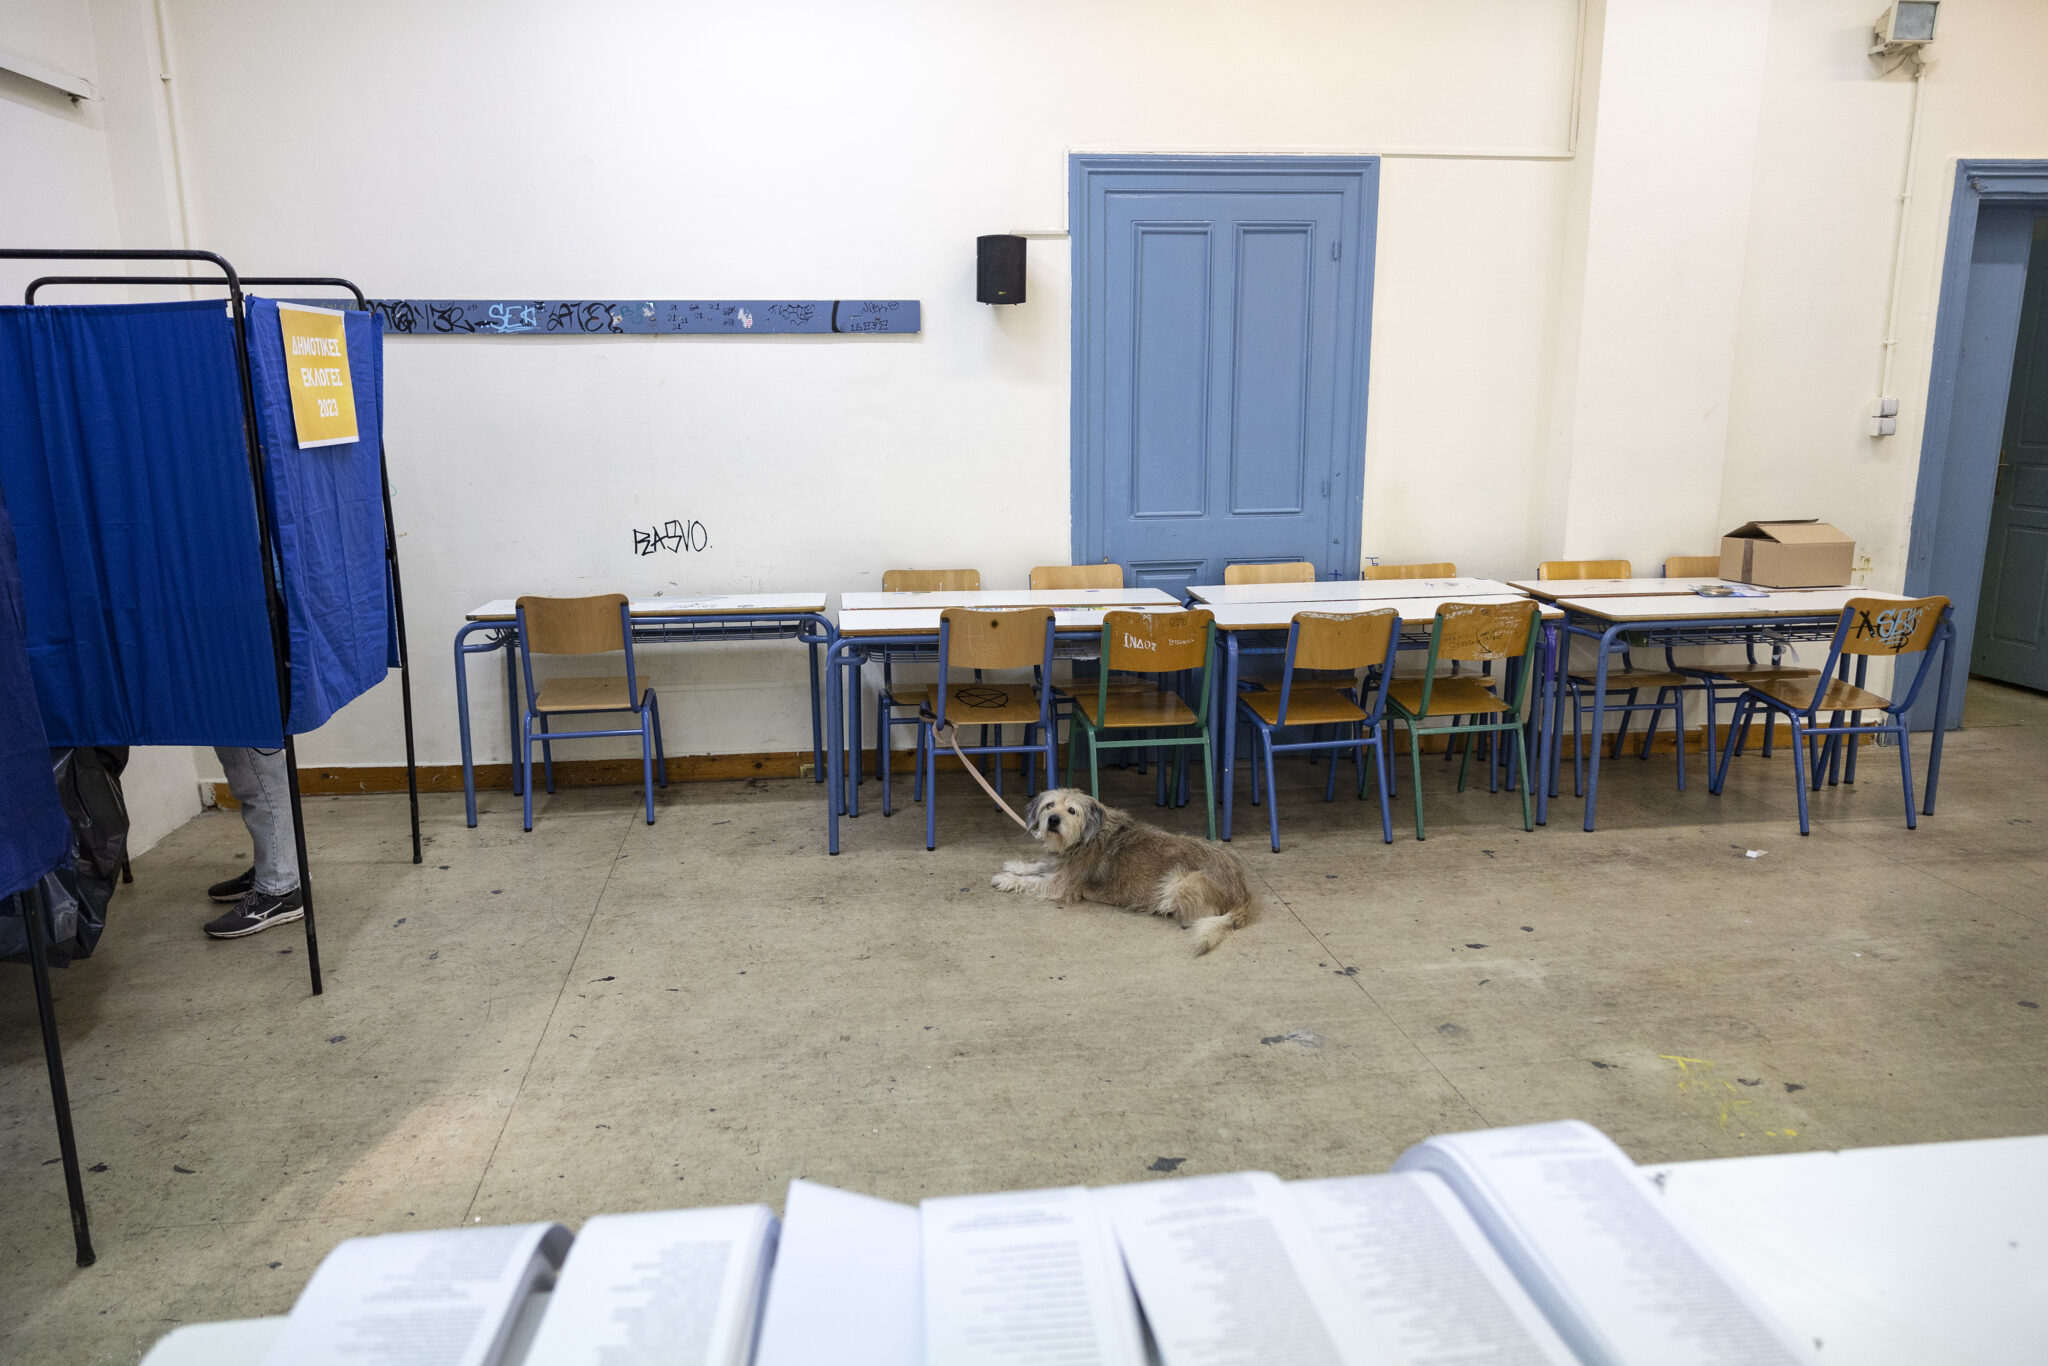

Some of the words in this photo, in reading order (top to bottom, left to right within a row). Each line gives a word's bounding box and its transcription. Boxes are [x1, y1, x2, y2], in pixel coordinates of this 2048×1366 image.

[292, 336, 342, 357] ΔΗΜΟΤΙΚΕΣ
[300, 368, 343, 387] ΕΚΛΟΓΕΣ
[317, 398, 339, 418] 2023
